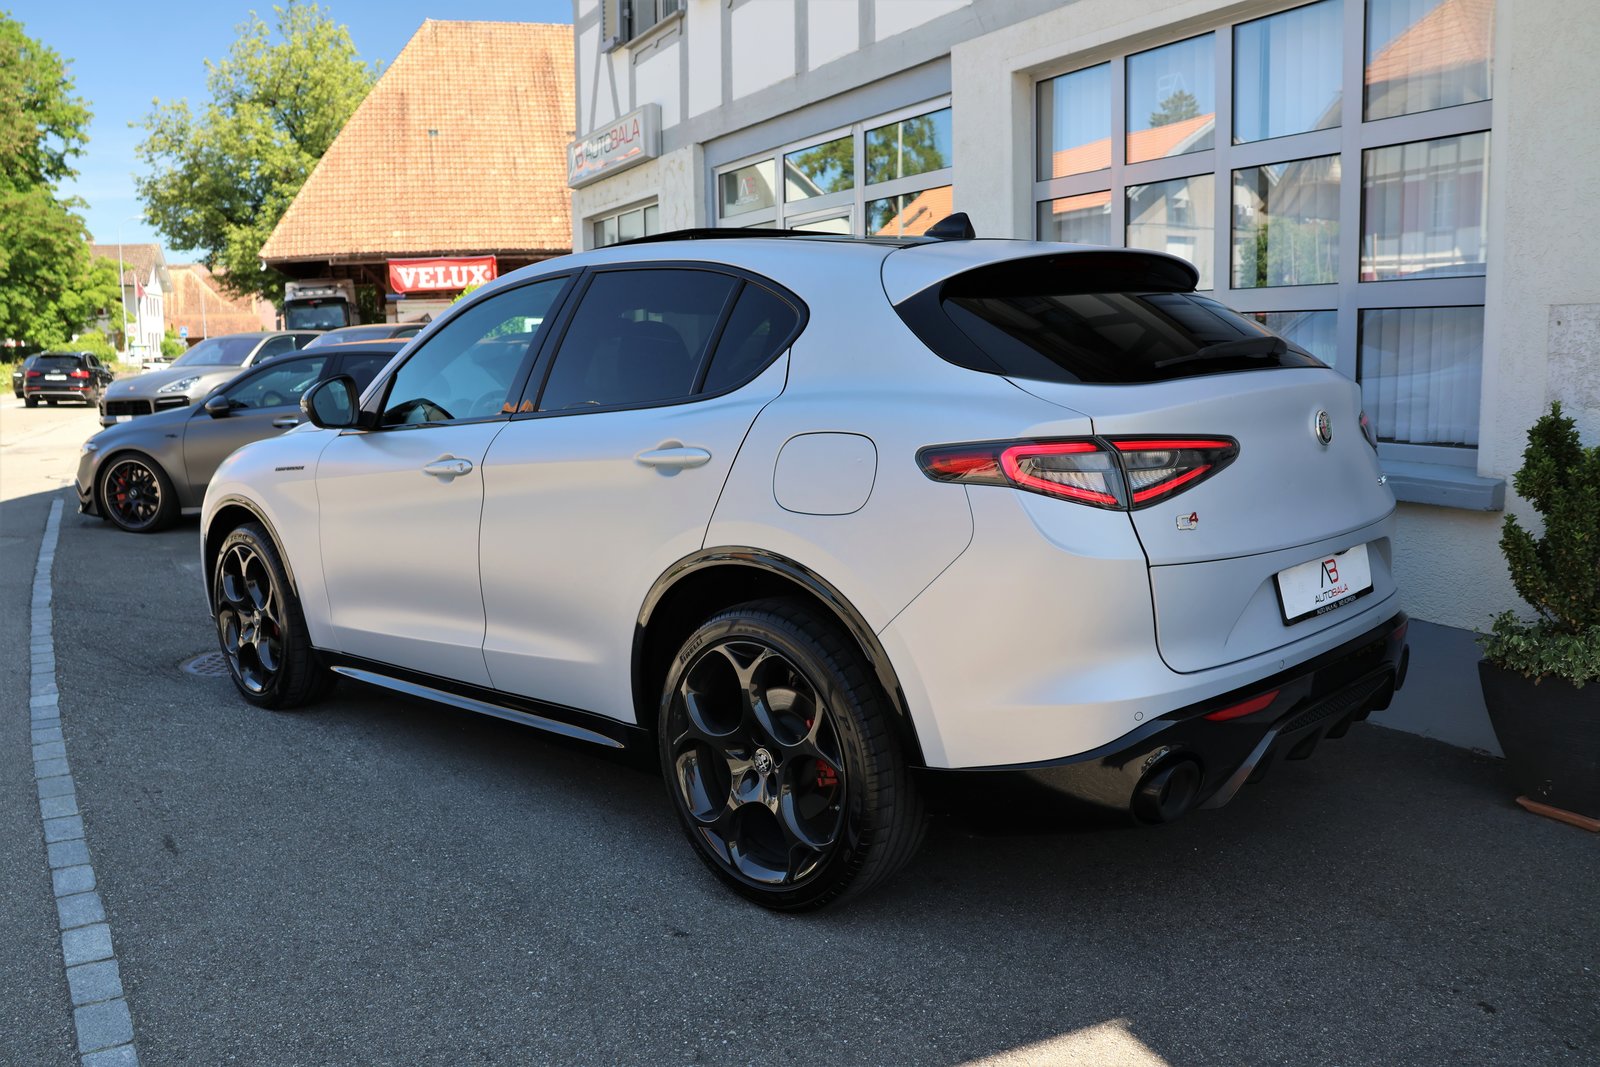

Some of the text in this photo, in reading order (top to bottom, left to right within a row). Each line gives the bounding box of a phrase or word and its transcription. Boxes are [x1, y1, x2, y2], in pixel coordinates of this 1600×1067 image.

[585, 118, 640, 159] AUTOBALA
[397, 265, 488, 288] VELUX
[1314, 584, 1349, 604] AUTOBALA
[680, 634, 703, 664] PIRELLI
